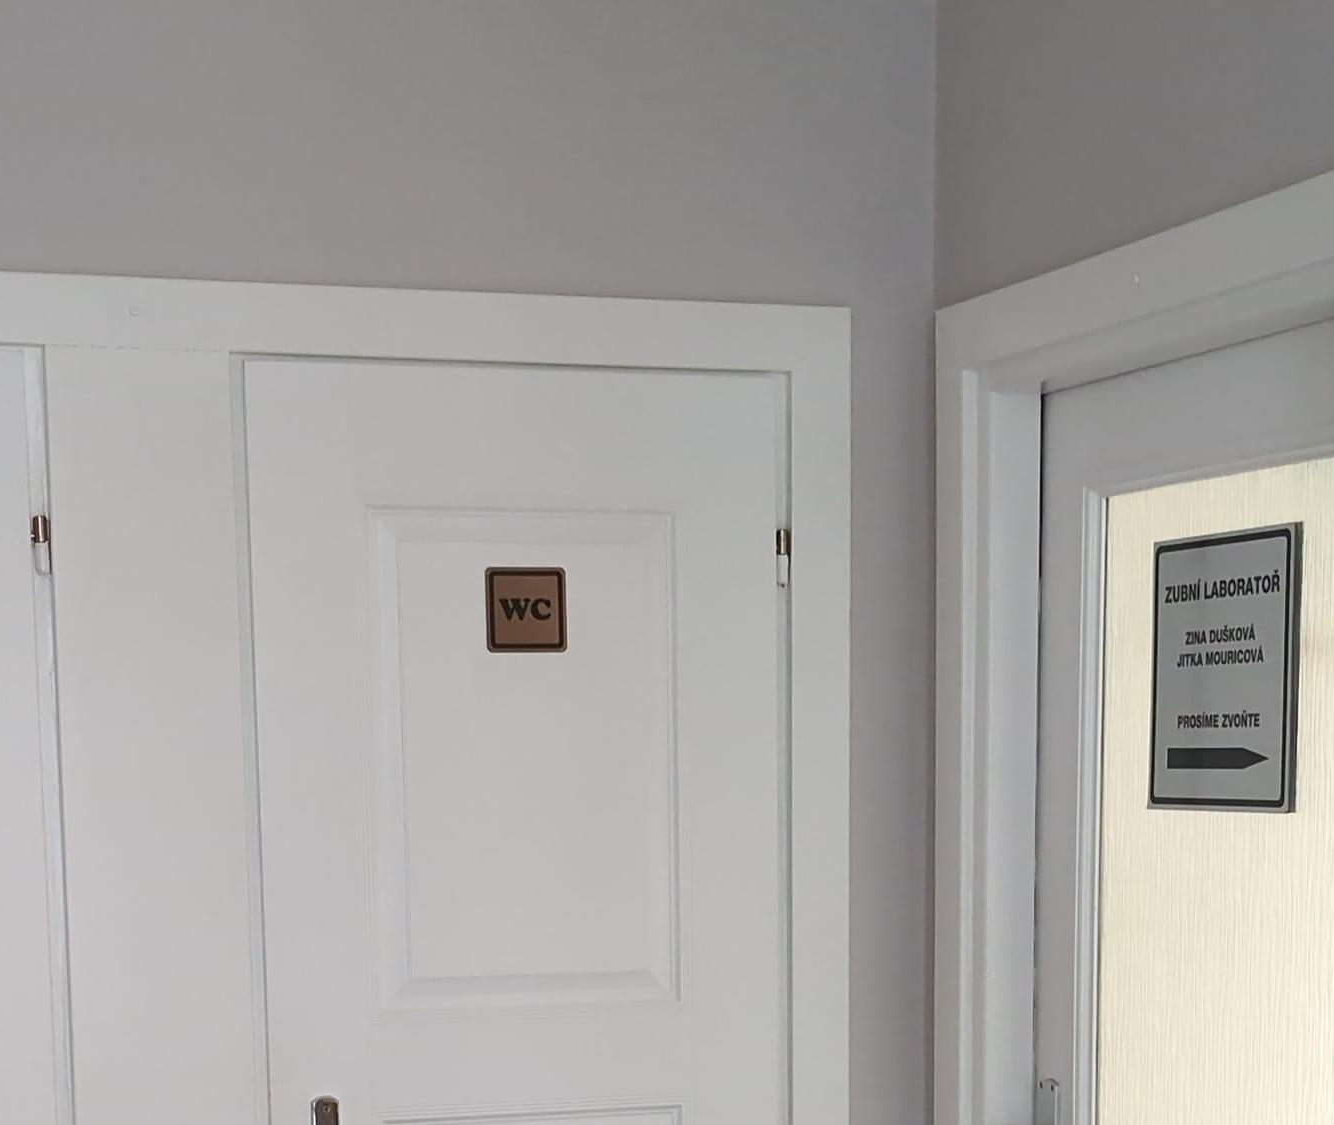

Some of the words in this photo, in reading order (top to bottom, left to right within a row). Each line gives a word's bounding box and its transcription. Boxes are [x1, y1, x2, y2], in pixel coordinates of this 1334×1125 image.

[1164, 577, 1201, 604] ZUBNÍ
[1204, 569, 1280, 600] LABORATOŘ
[498, 597, 551, 621] WC
[1185, 630, 1207, 645] ZINA
[1209, 623, 1255, 644] DUŠKOVÁ
[1177, 652, 1203, 668] JITKA
[1205, 645, 1264, 666] MOURICOVÁ
[1177, 711, 1219, 729] PROSÍME
[1221, 709, 1260, 729] ZVOŇTE
